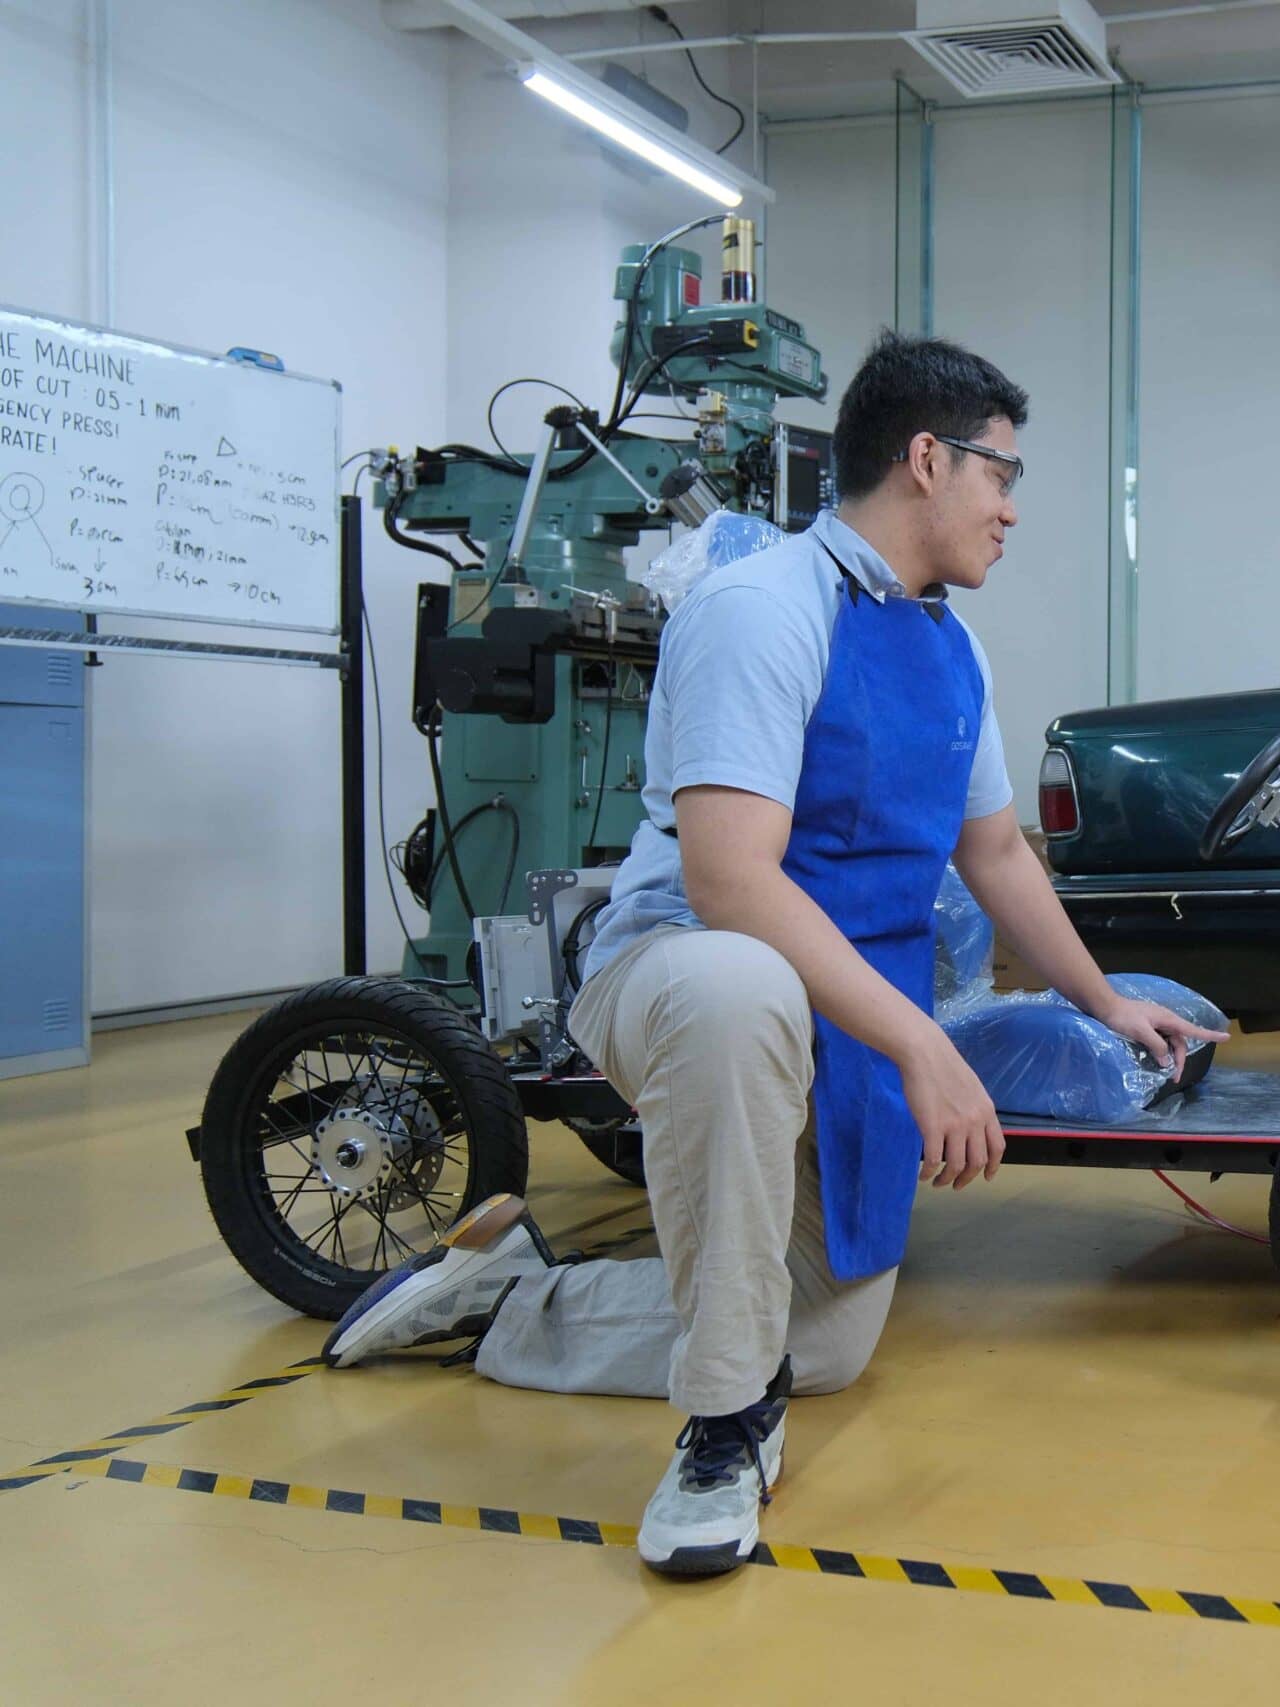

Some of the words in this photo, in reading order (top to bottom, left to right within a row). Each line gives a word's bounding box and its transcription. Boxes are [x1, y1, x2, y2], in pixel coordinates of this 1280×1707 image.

[36, 338, 135, 385] MACHINE
[2, 368, 24, 389] OF
[37, 376, 70, 398] CUT
[62, 411, 119, 438] PRESS!
[1, 426, 56, 454] RATE!
